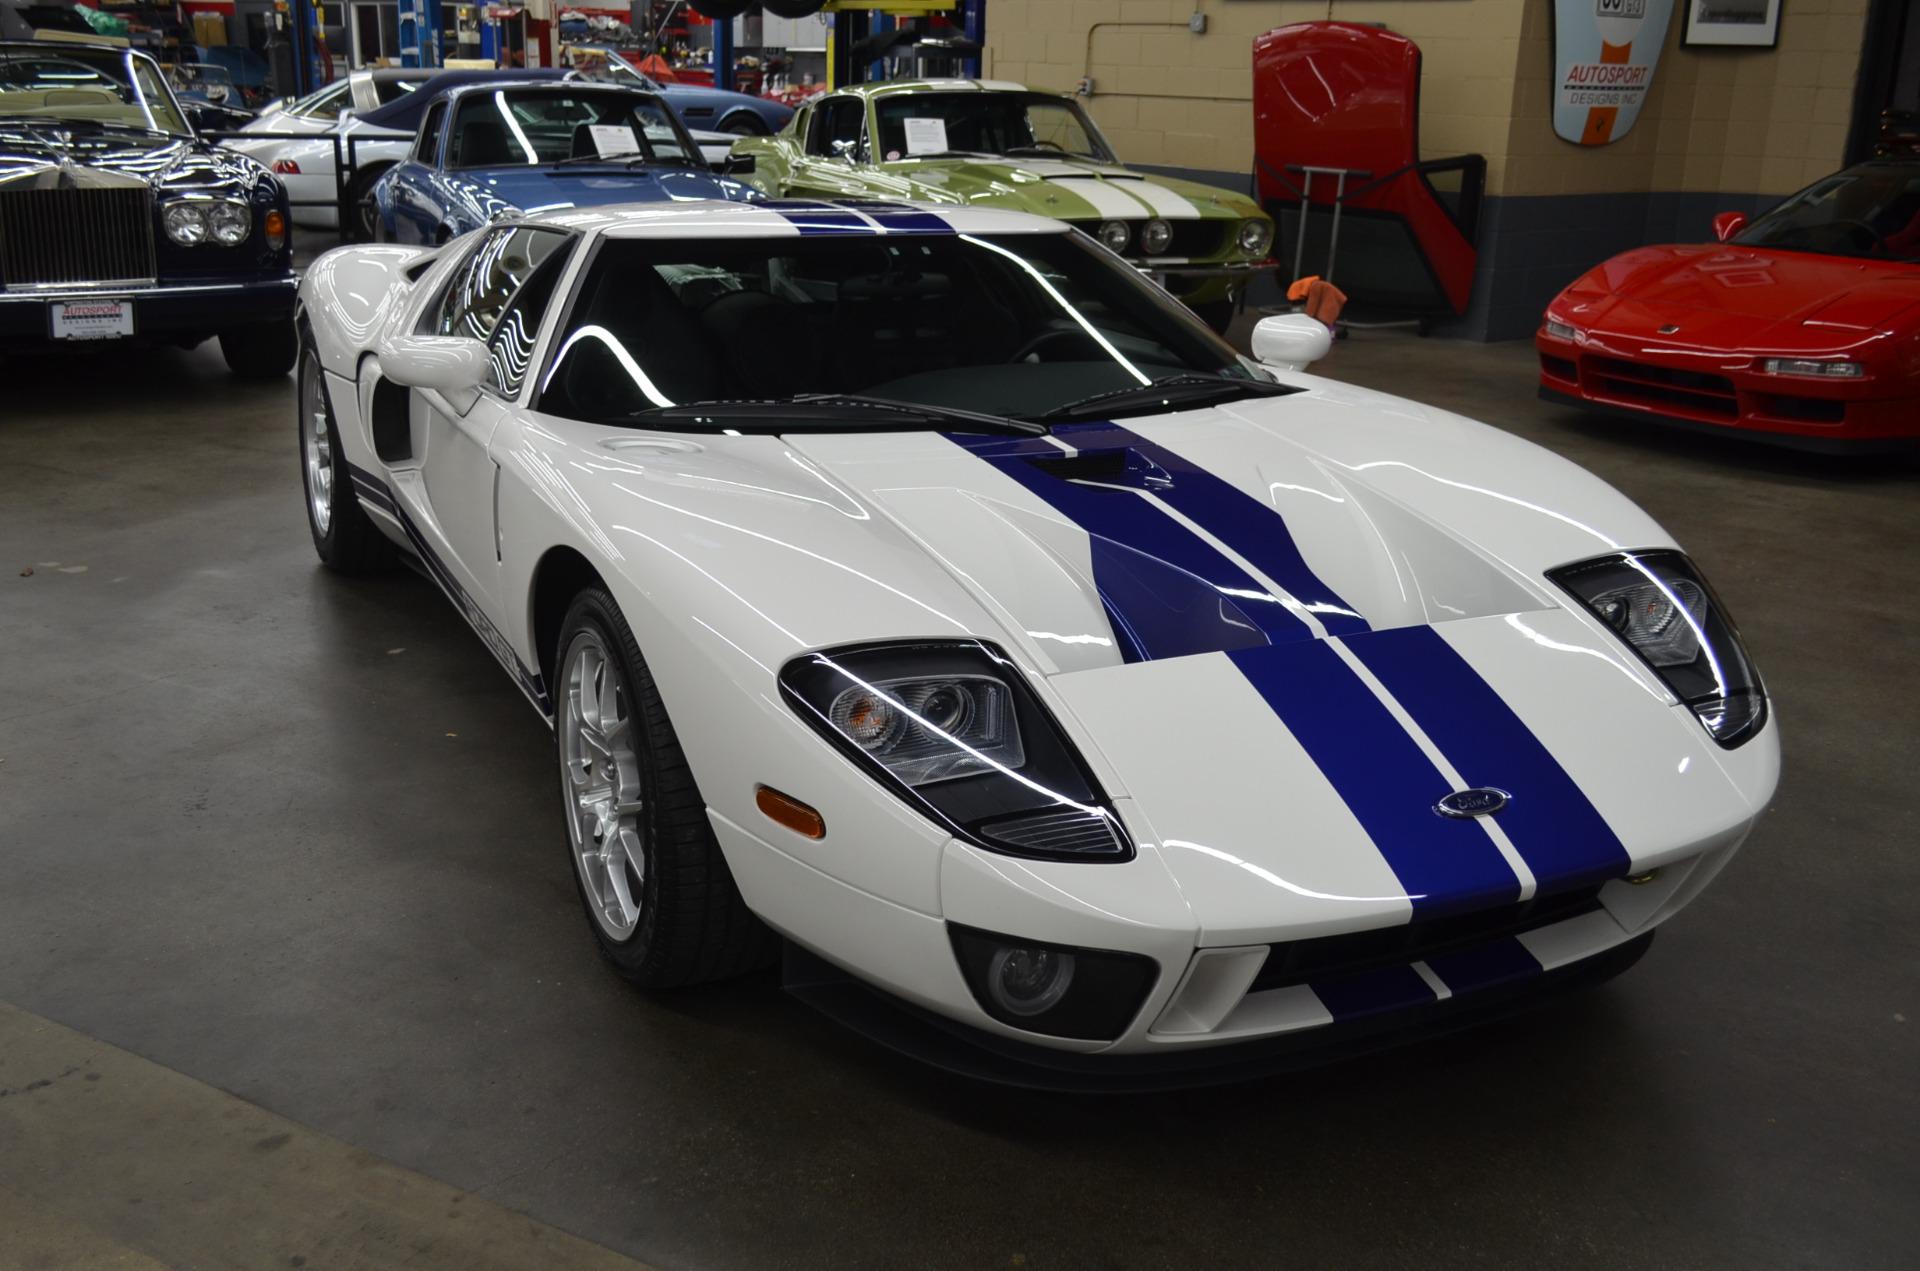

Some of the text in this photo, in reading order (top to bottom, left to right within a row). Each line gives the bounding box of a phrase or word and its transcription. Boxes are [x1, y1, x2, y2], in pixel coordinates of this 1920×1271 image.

[1567, 65, 1648, 84] AUTOSPORT
[1570, 92, 1619, 105] DESIGNS
[63, 305, 122, 316] AUTOSPORT
